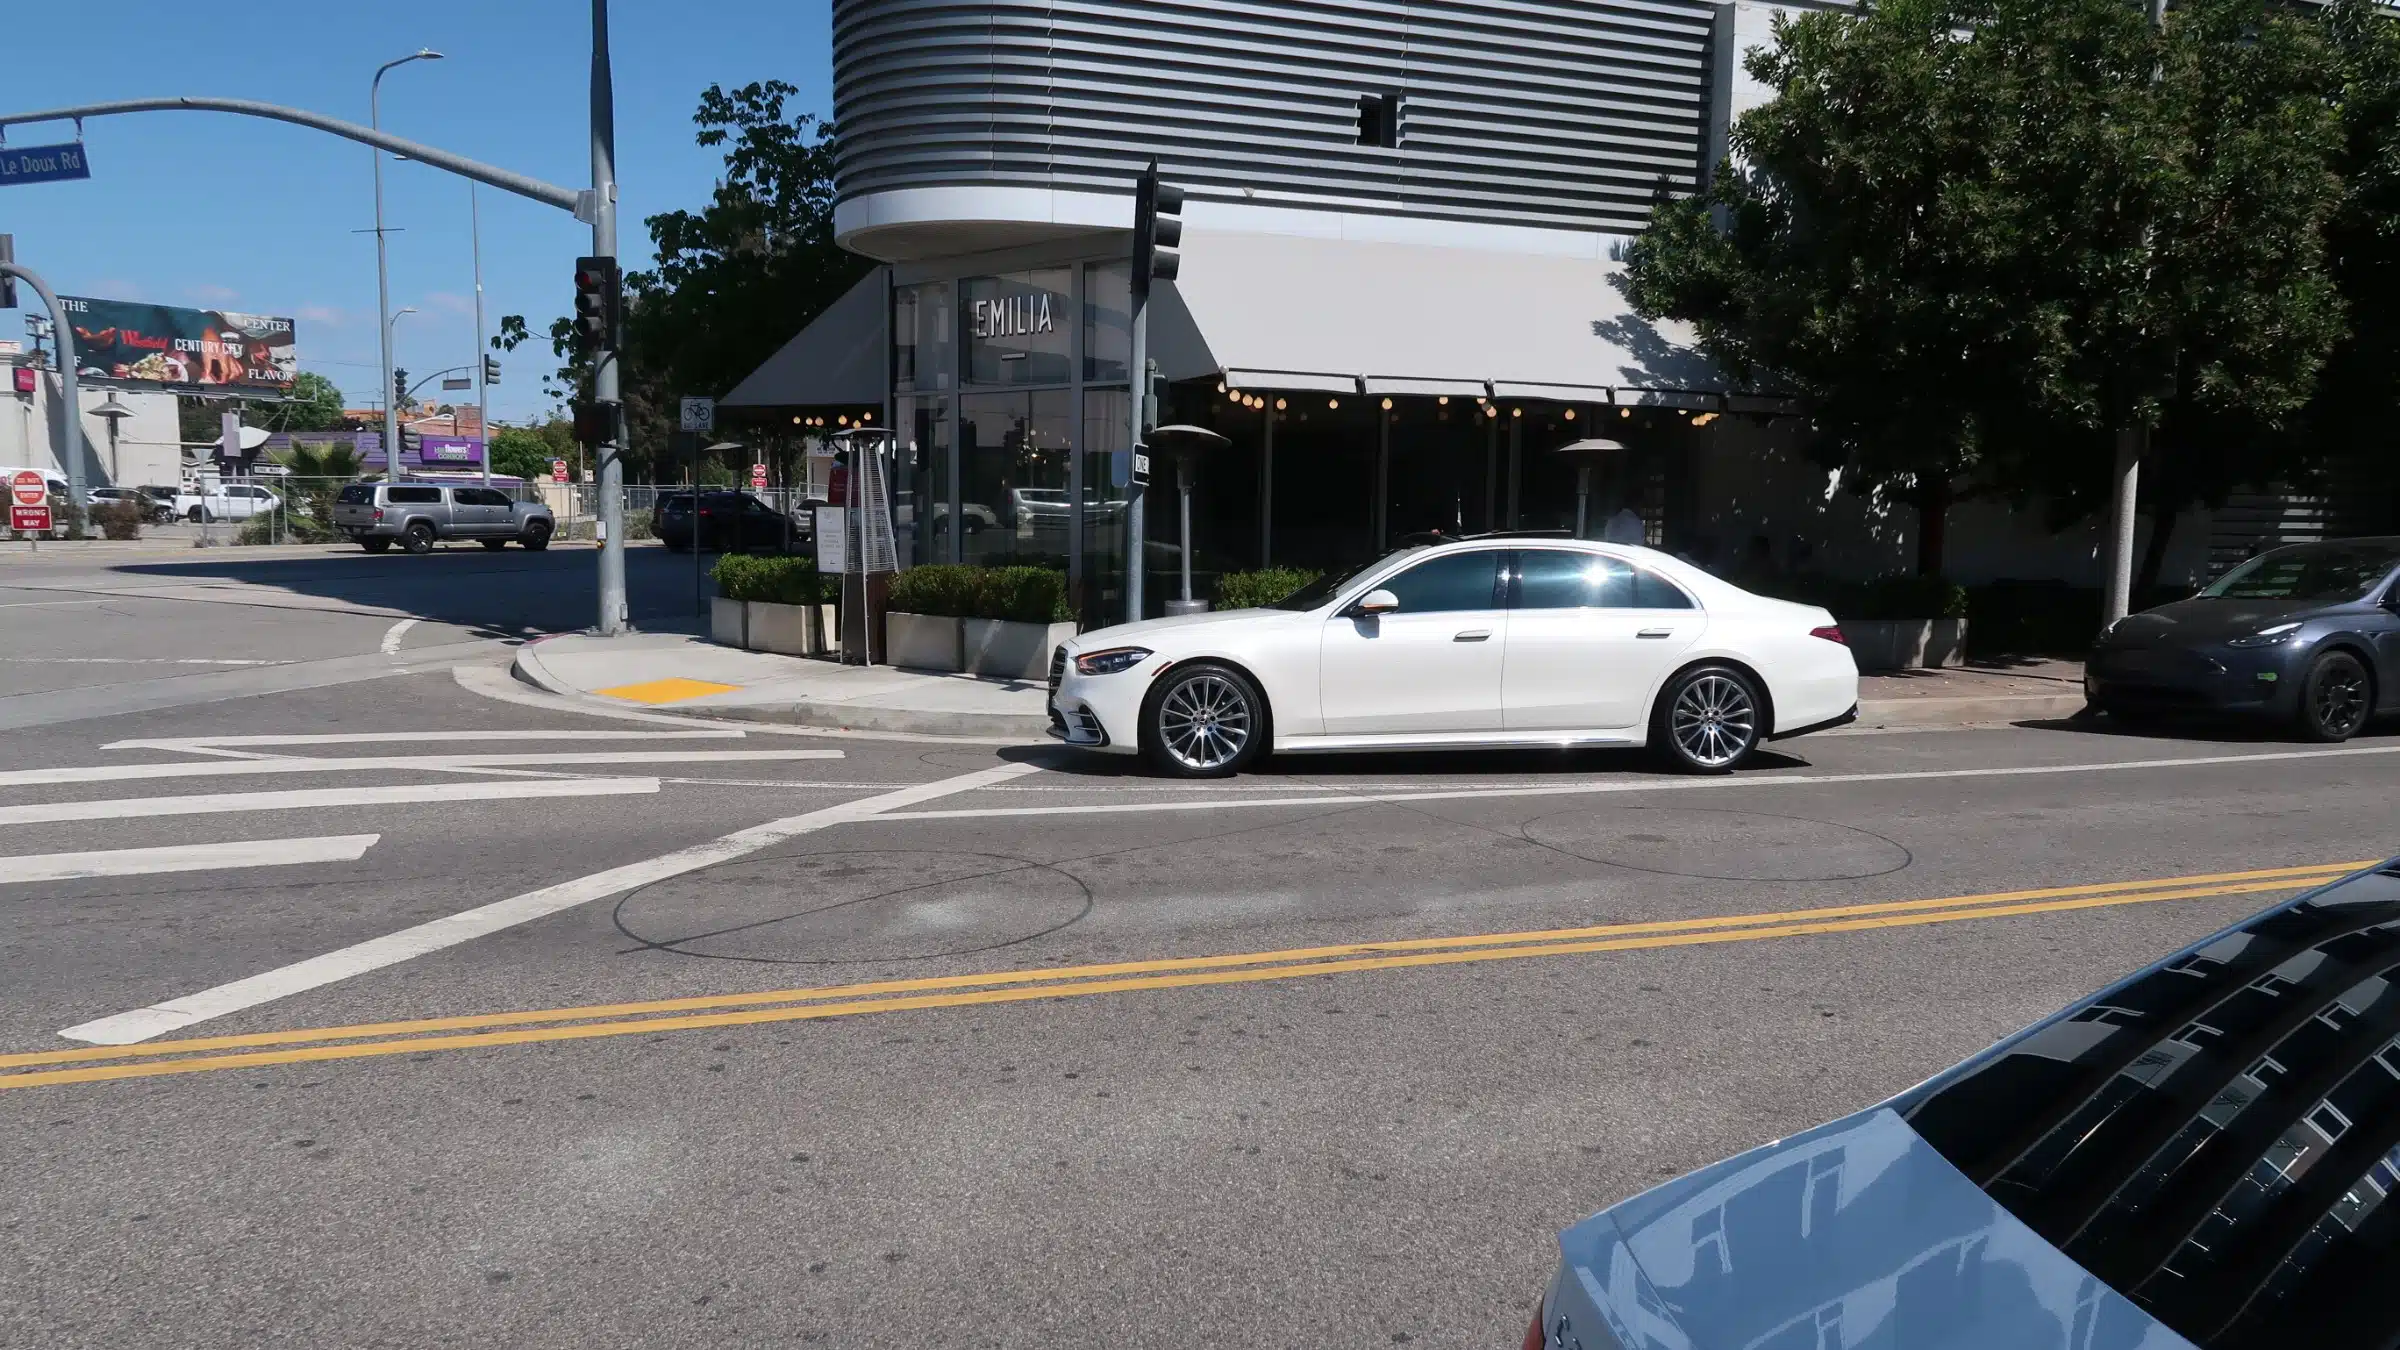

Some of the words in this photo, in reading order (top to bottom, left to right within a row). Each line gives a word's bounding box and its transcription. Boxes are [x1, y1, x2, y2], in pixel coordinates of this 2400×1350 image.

[1, 158, 17, 175] Le
[21, 155, 57, 173] Doux
[61, 151, 80, 170] Rd
[60, 299, 88, 312] THE
[976, 293, 1053, 338] EMILIA
[244, 319, 291, 332] CENTER
[175, 338, 219, 354] CENTURY
[248, 368, 293, 381] FLAVOR
[1136, 456, 1147, 472] ONE
[15, 509, 46, 517] WRONG
[22, 519, 40, 527] WAY
